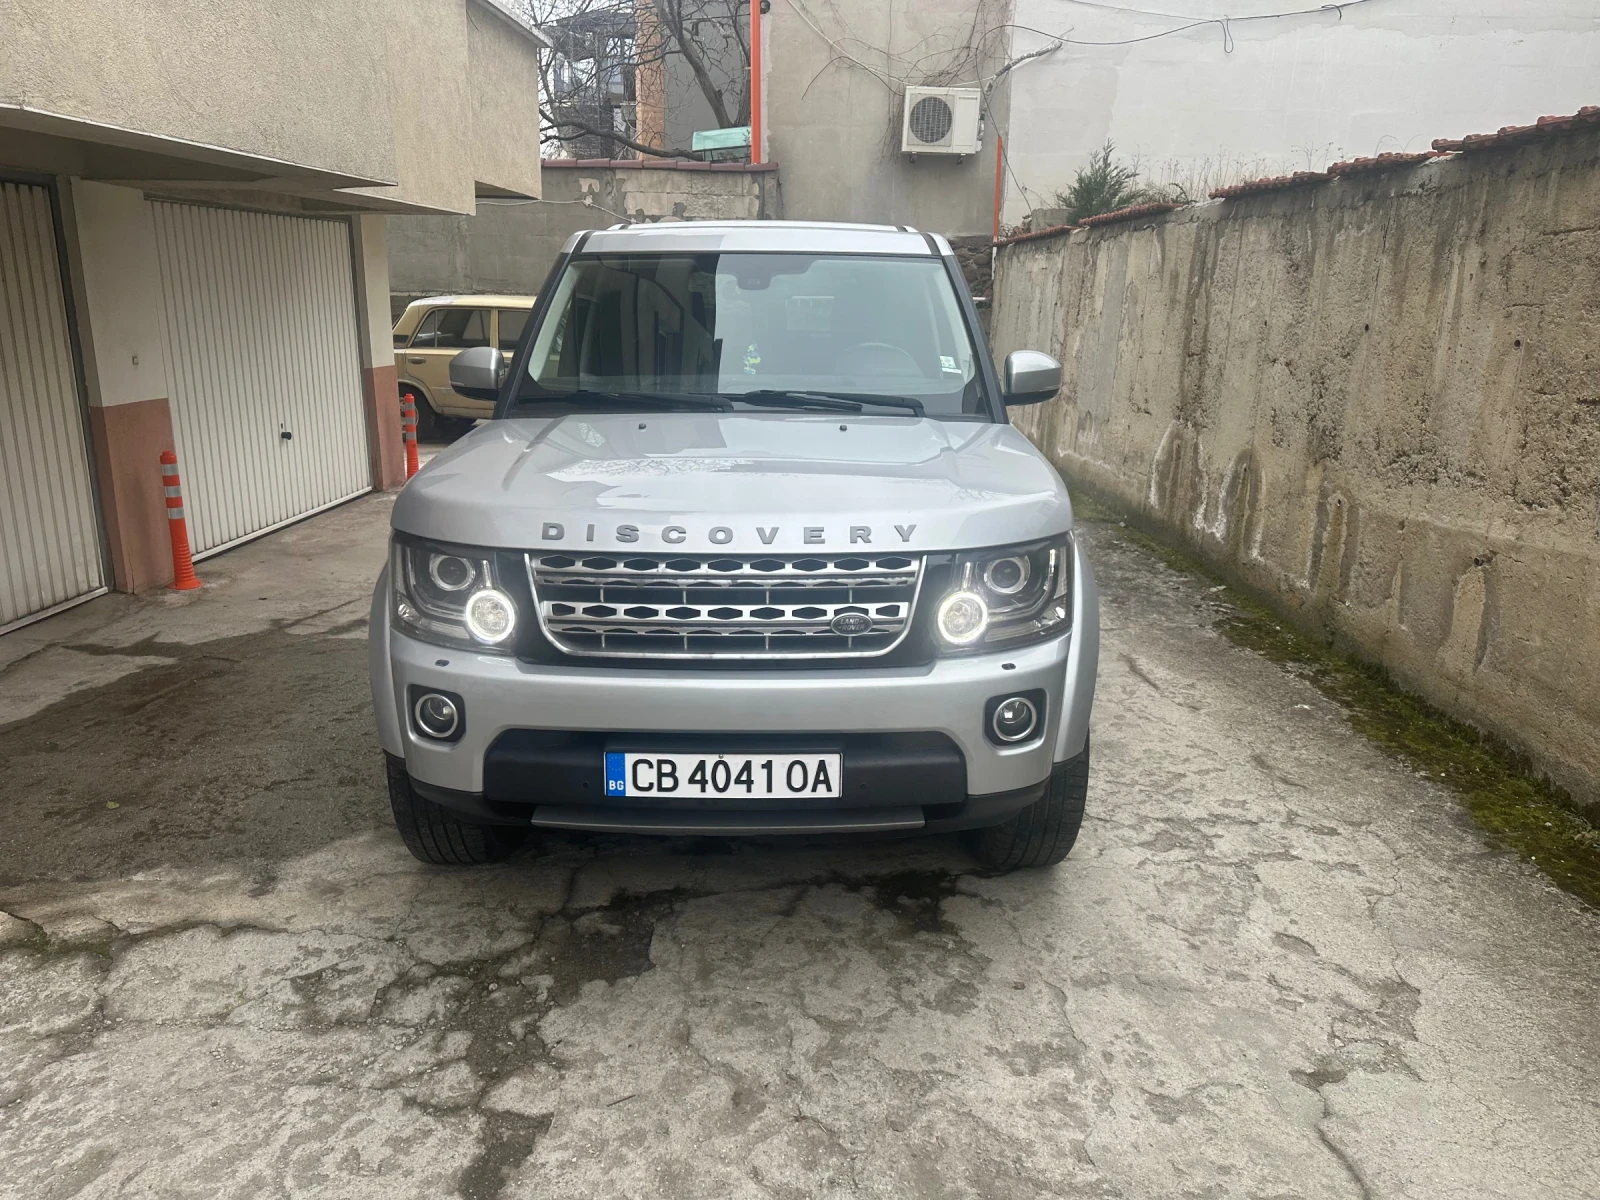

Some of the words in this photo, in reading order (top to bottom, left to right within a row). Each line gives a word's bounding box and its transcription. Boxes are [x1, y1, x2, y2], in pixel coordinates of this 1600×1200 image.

[541, 522, 917, 545] DISCOVERY
[608, 780, 625, 791] BG
[631, 758, 679, 792] CB
[688, 759, 773, 793] 4041
[786, 759, 833, 793] OA
